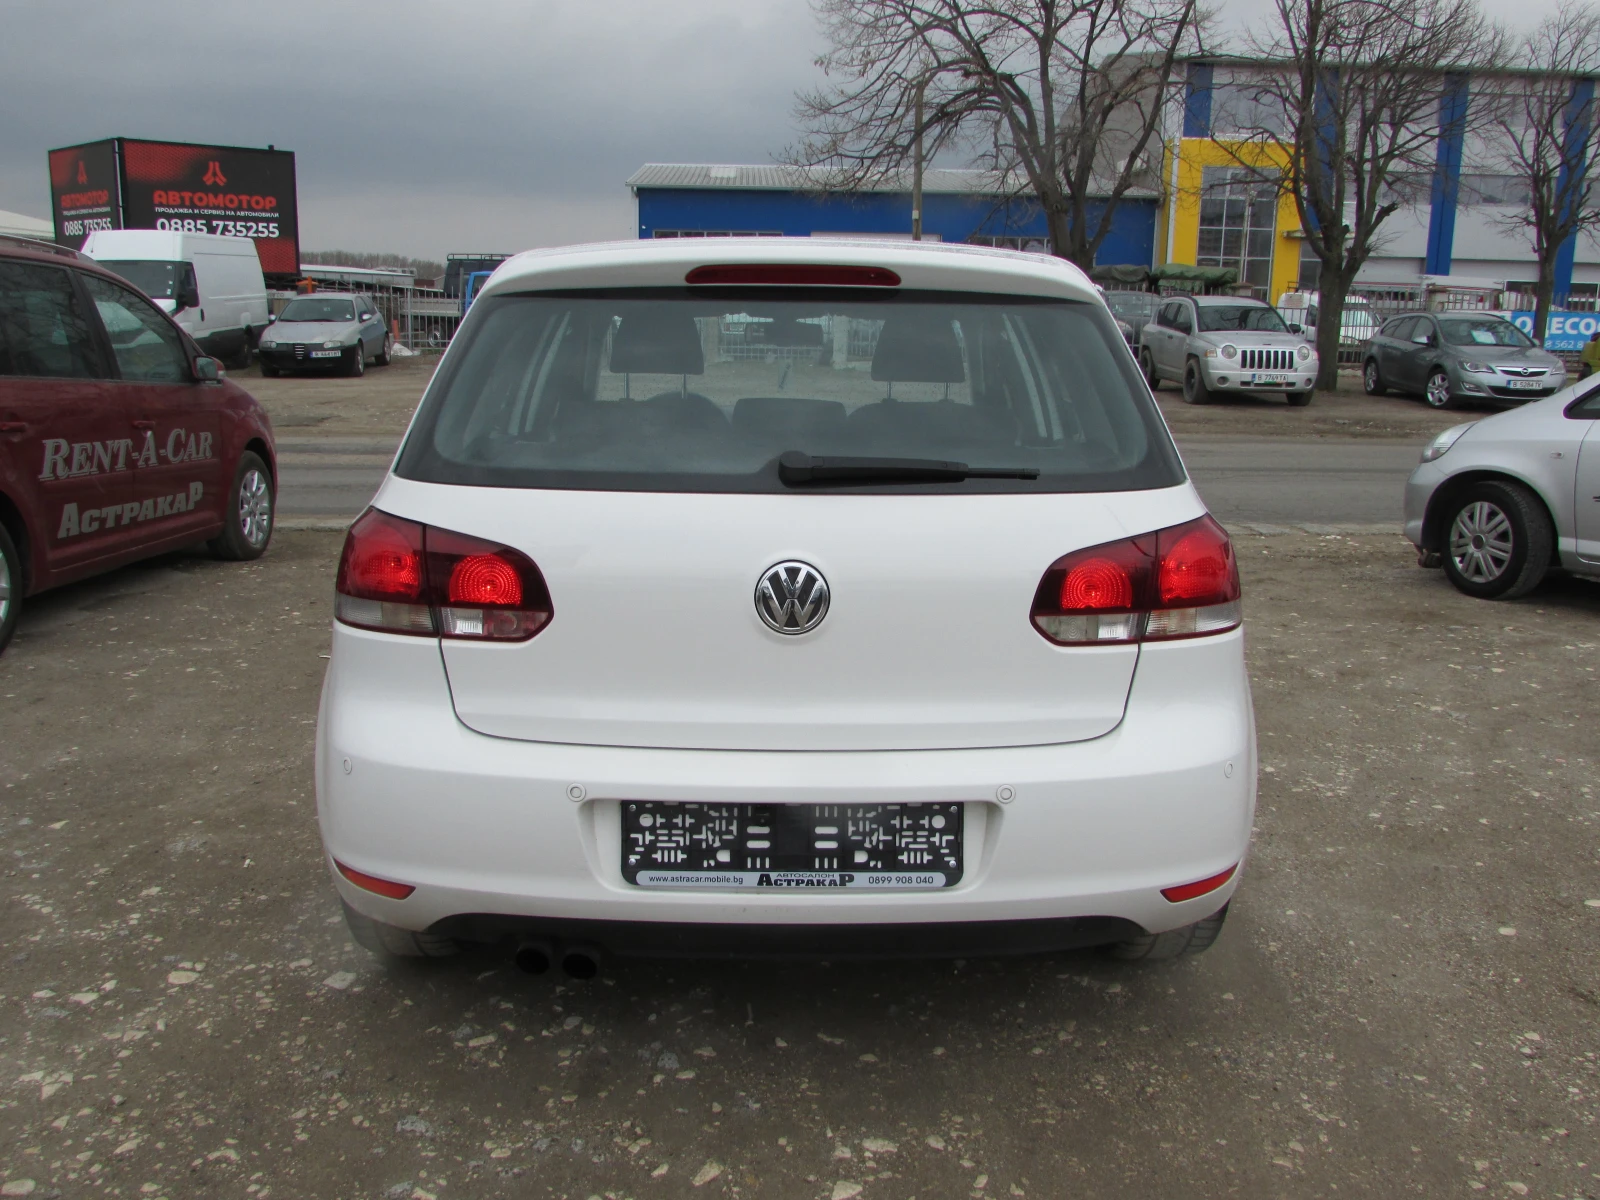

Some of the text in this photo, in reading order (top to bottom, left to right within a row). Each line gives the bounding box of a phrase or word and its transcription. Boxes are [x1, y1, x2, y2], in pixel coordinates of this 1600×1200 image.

[153, 190, 277, 210] АВТОМОТОР
[155, 206, 192, 214] ПРОДАЖБА
[64, 221, 83, 236] 0885
[156, 218, 280, 238] 0885 735255
[648, 875, 744, 885] www.astracar.mobile.bg
[868, 876, 934, 884] 0899 908 040
